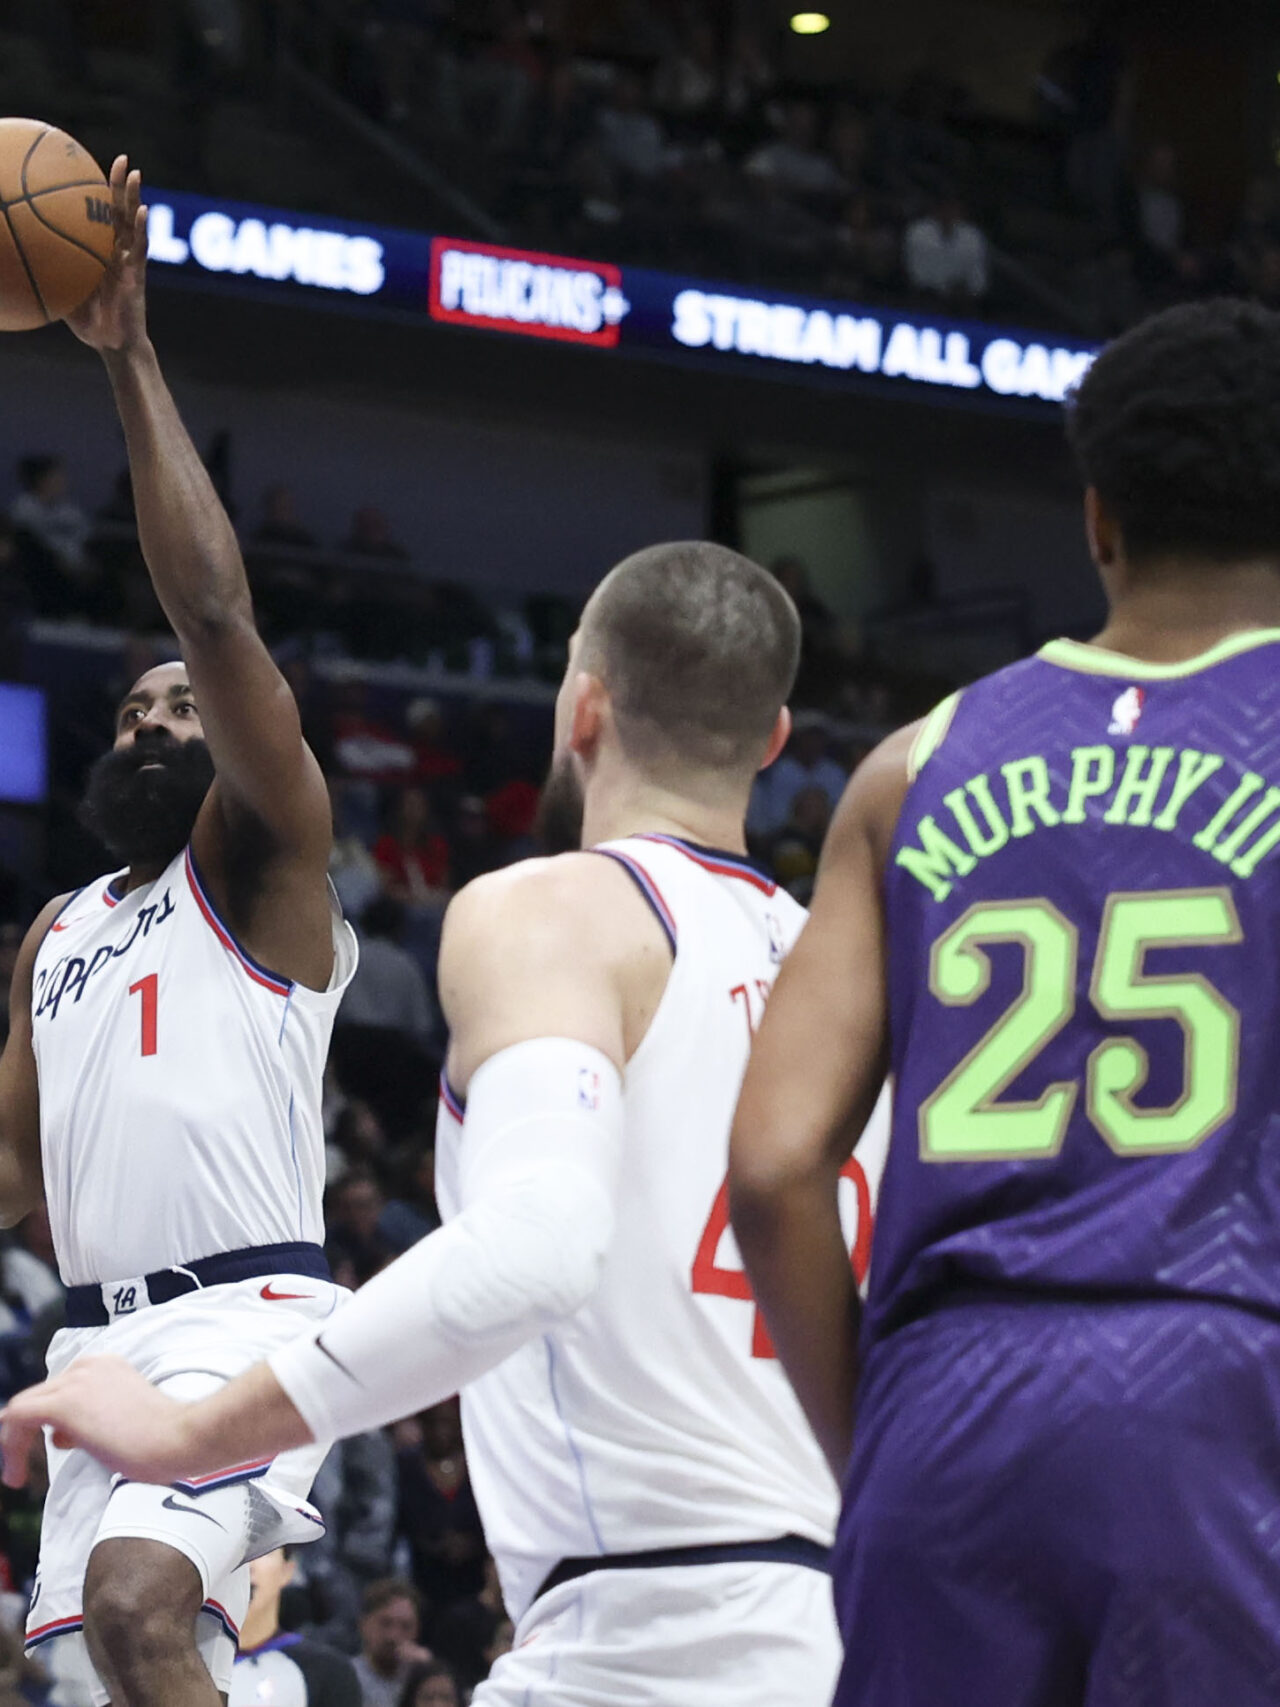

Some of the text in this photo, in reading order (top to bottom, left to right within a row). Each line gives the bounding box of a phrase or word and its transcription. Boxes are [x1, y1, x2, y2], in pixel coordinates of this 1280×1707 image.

[190, 213, 384, 293] GAMES
[672, 290, 1098, 401] STREAM ALL GAM
[895, 745, 1224, 902] MURPHY
[128, 972, 158, 1057] 1
[919, 886, 1244, 1163] 25
